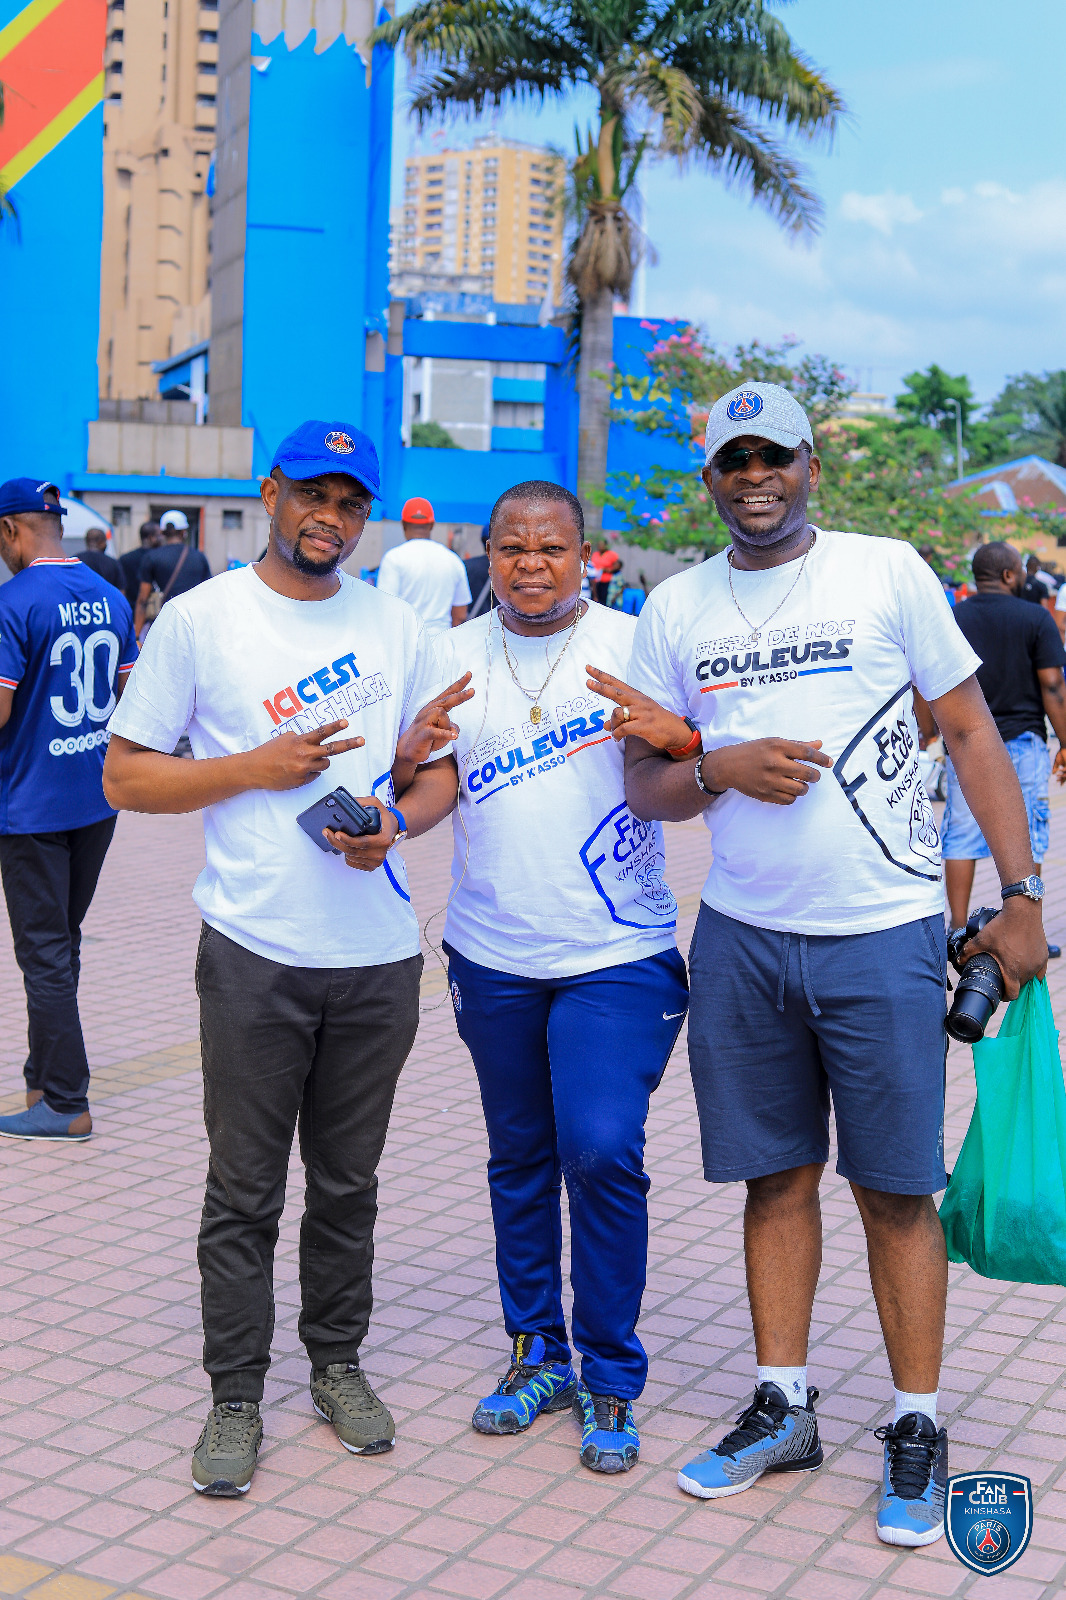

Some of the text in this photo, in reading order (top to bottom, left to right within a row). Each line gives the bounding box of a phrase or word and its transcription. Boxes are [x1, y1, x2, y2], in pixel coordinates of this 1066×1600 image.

[768, 625, 800, 647] DE
[805, 619, 856, 640] NOS
[49, 630, 119, 727] 30
[695, 638, 854, 682] COULEURS
[740, 670, 798, 687] BY K'ASSO
[262, 652, 361, 726] ICI C'EST
[467, 708, 606, 793] COULEURS
[509, 754, 566, 787] BY K'ASSO
[876, 731, 914, 782] CLUB
